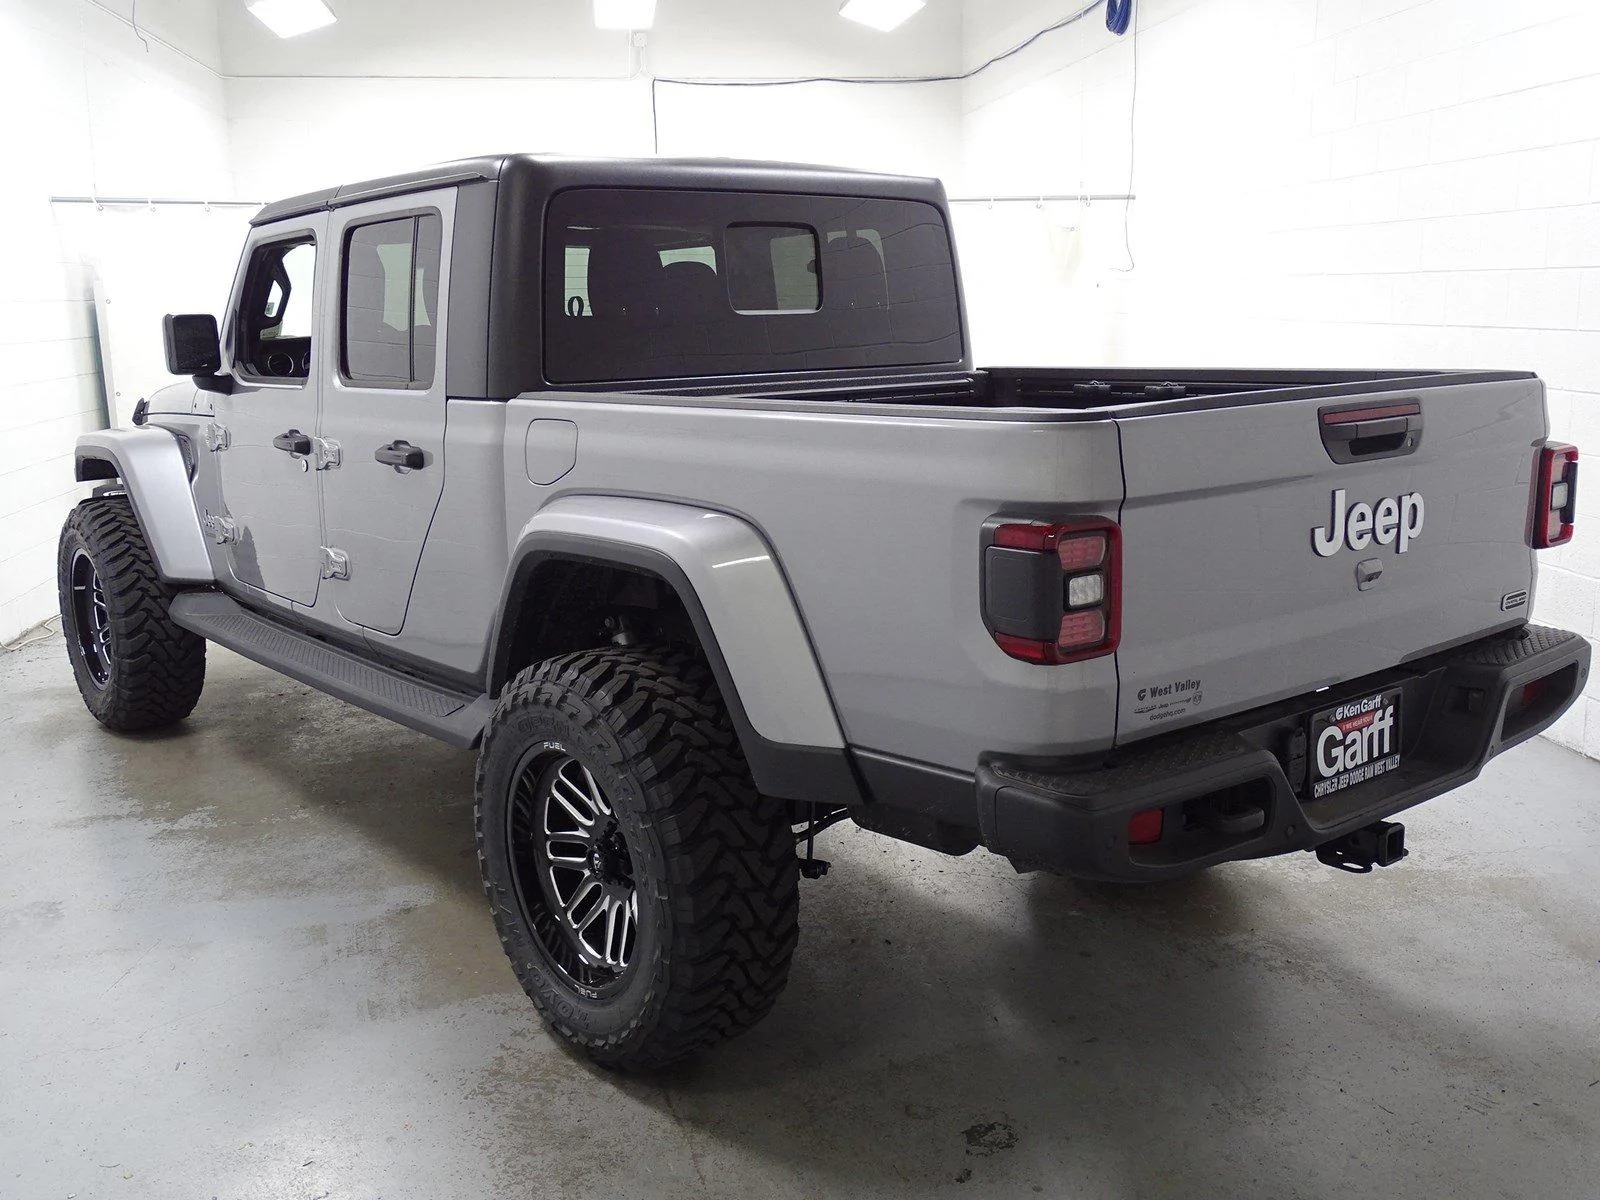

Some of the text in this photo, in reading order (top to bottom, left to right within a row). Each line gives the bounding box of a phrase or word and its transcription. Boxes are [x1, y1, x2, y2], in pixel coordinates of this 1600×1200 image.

[1310, 488, 1424, 557] Jeep
[1150, 684, 1172, 698] West
[1175, 680, 1201, 692] Valley
[1343, 704, 1360, 718] Ken
[1361, 695, 1382, 712] Garff
[543, 741, 566, 752] FUEL
[1316, 705, 1394, 778] Garff
[1314, 777, 1338, 798] CHRYSLER
[1338, 773, 1350, 790] JEEP
[1349, 768, 1365, 786] DODGE
[1374, 760, 1386, 776] WEST
[1385, 754, 1400, 772] VALLEY
[574, 984, 598, 999] FUEL
